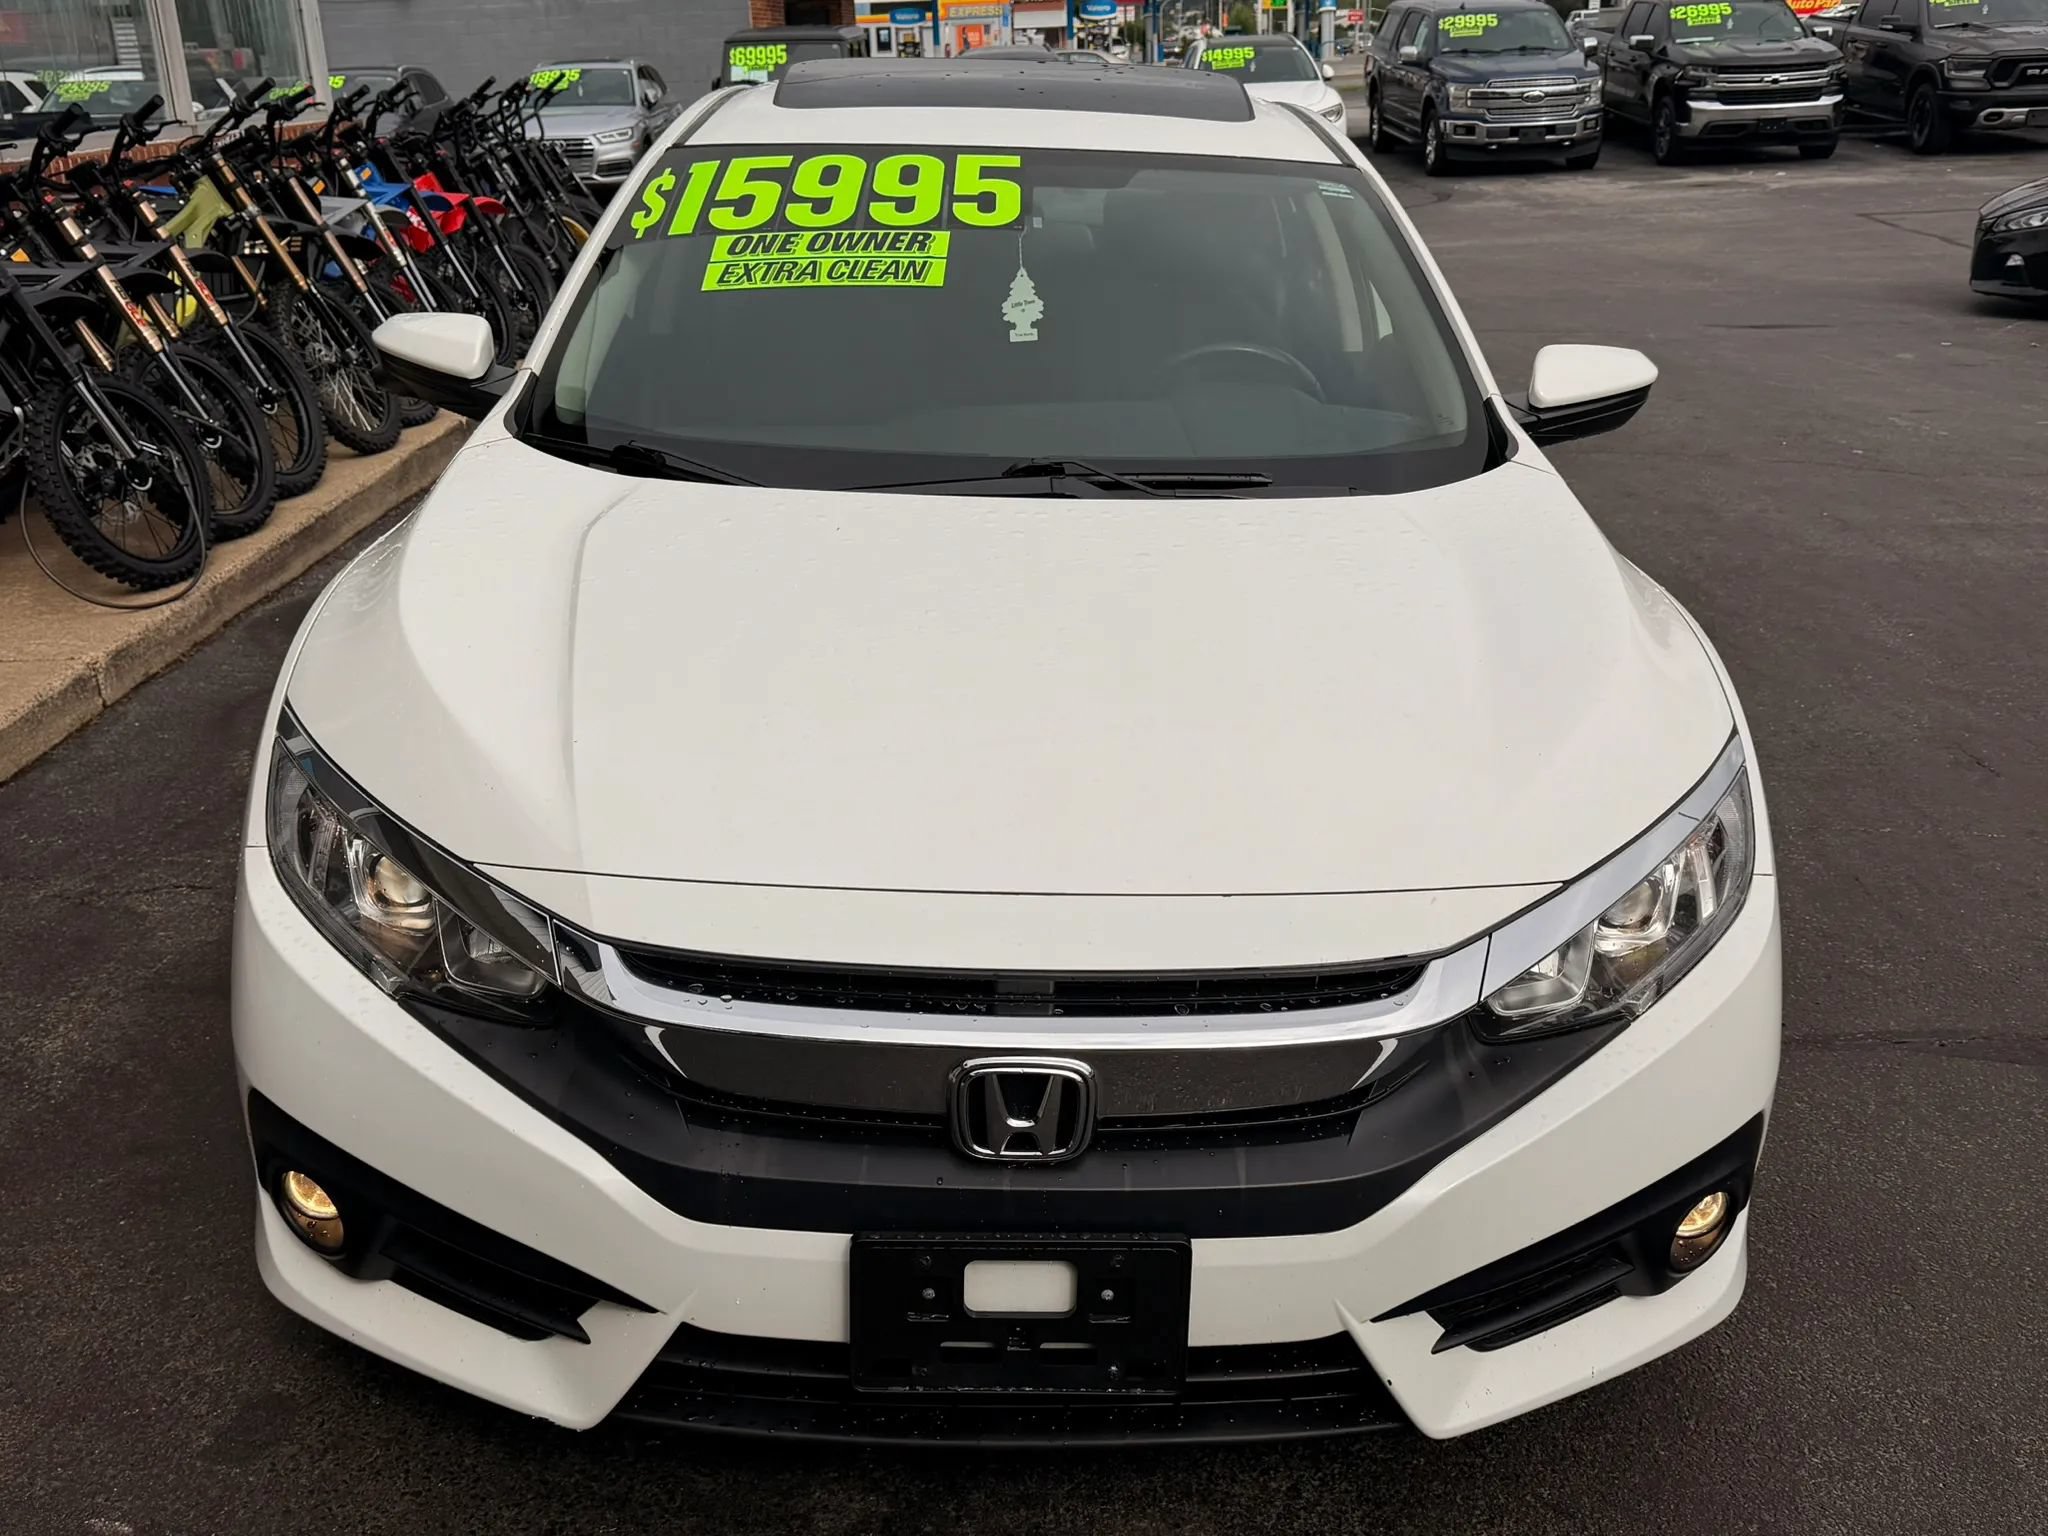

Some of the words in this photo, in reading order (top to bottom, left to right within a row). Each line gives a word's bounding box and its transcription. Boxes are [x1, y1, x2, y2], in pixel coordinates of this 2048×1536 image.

[949, 6, 1003, 18] EXPRESS
[1670, 2, 1732, 19] $26995
[1437, 13, 1498, 30] $29995
[729, 44, 788, 66] $69995
[1201, 46, 1255, 62] $14995
[630, 154, 1021, 239] $15995
[726, 233, 803, 257] ONE
[806, 231, 935, 254] OWNER
[717, 261, 823, 288] EXTRA
[826, 259, 931, 283] CLEAN
